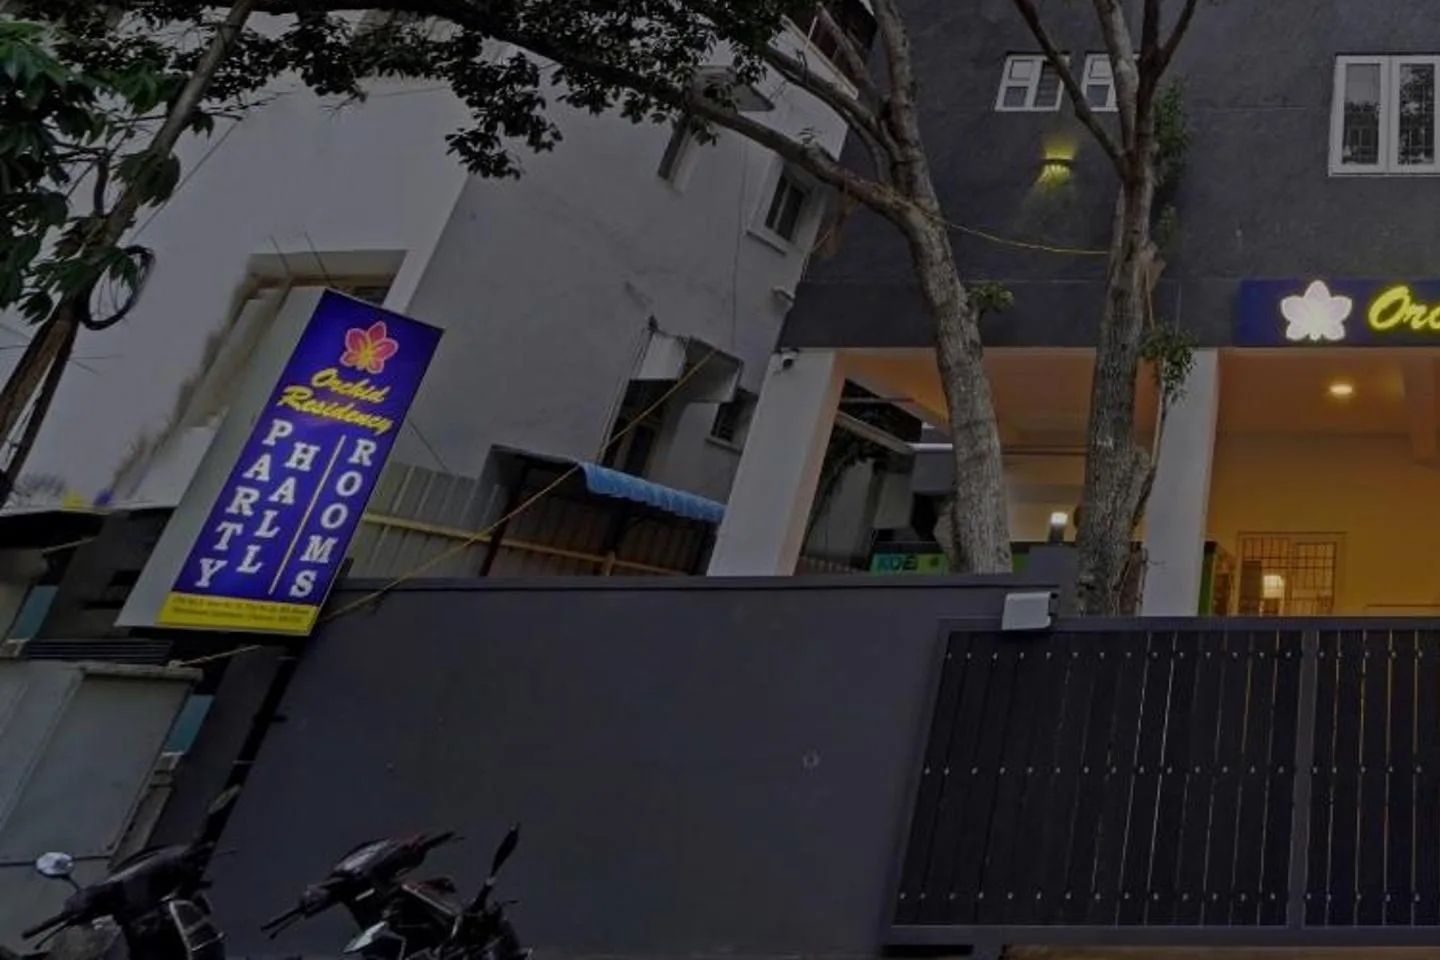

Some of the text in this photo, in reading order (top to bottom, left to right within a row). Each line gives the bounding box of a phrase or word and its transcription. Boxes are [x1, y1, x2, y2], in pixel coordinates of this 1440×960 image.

[276, 384, 394, 436] Residency
[311, 367, 391, 404] Orchid
[193, 418, 294, 589] PARTY
[237, 441, 320, 574] HALL
[289, 439, 377, 599] ROOMS
